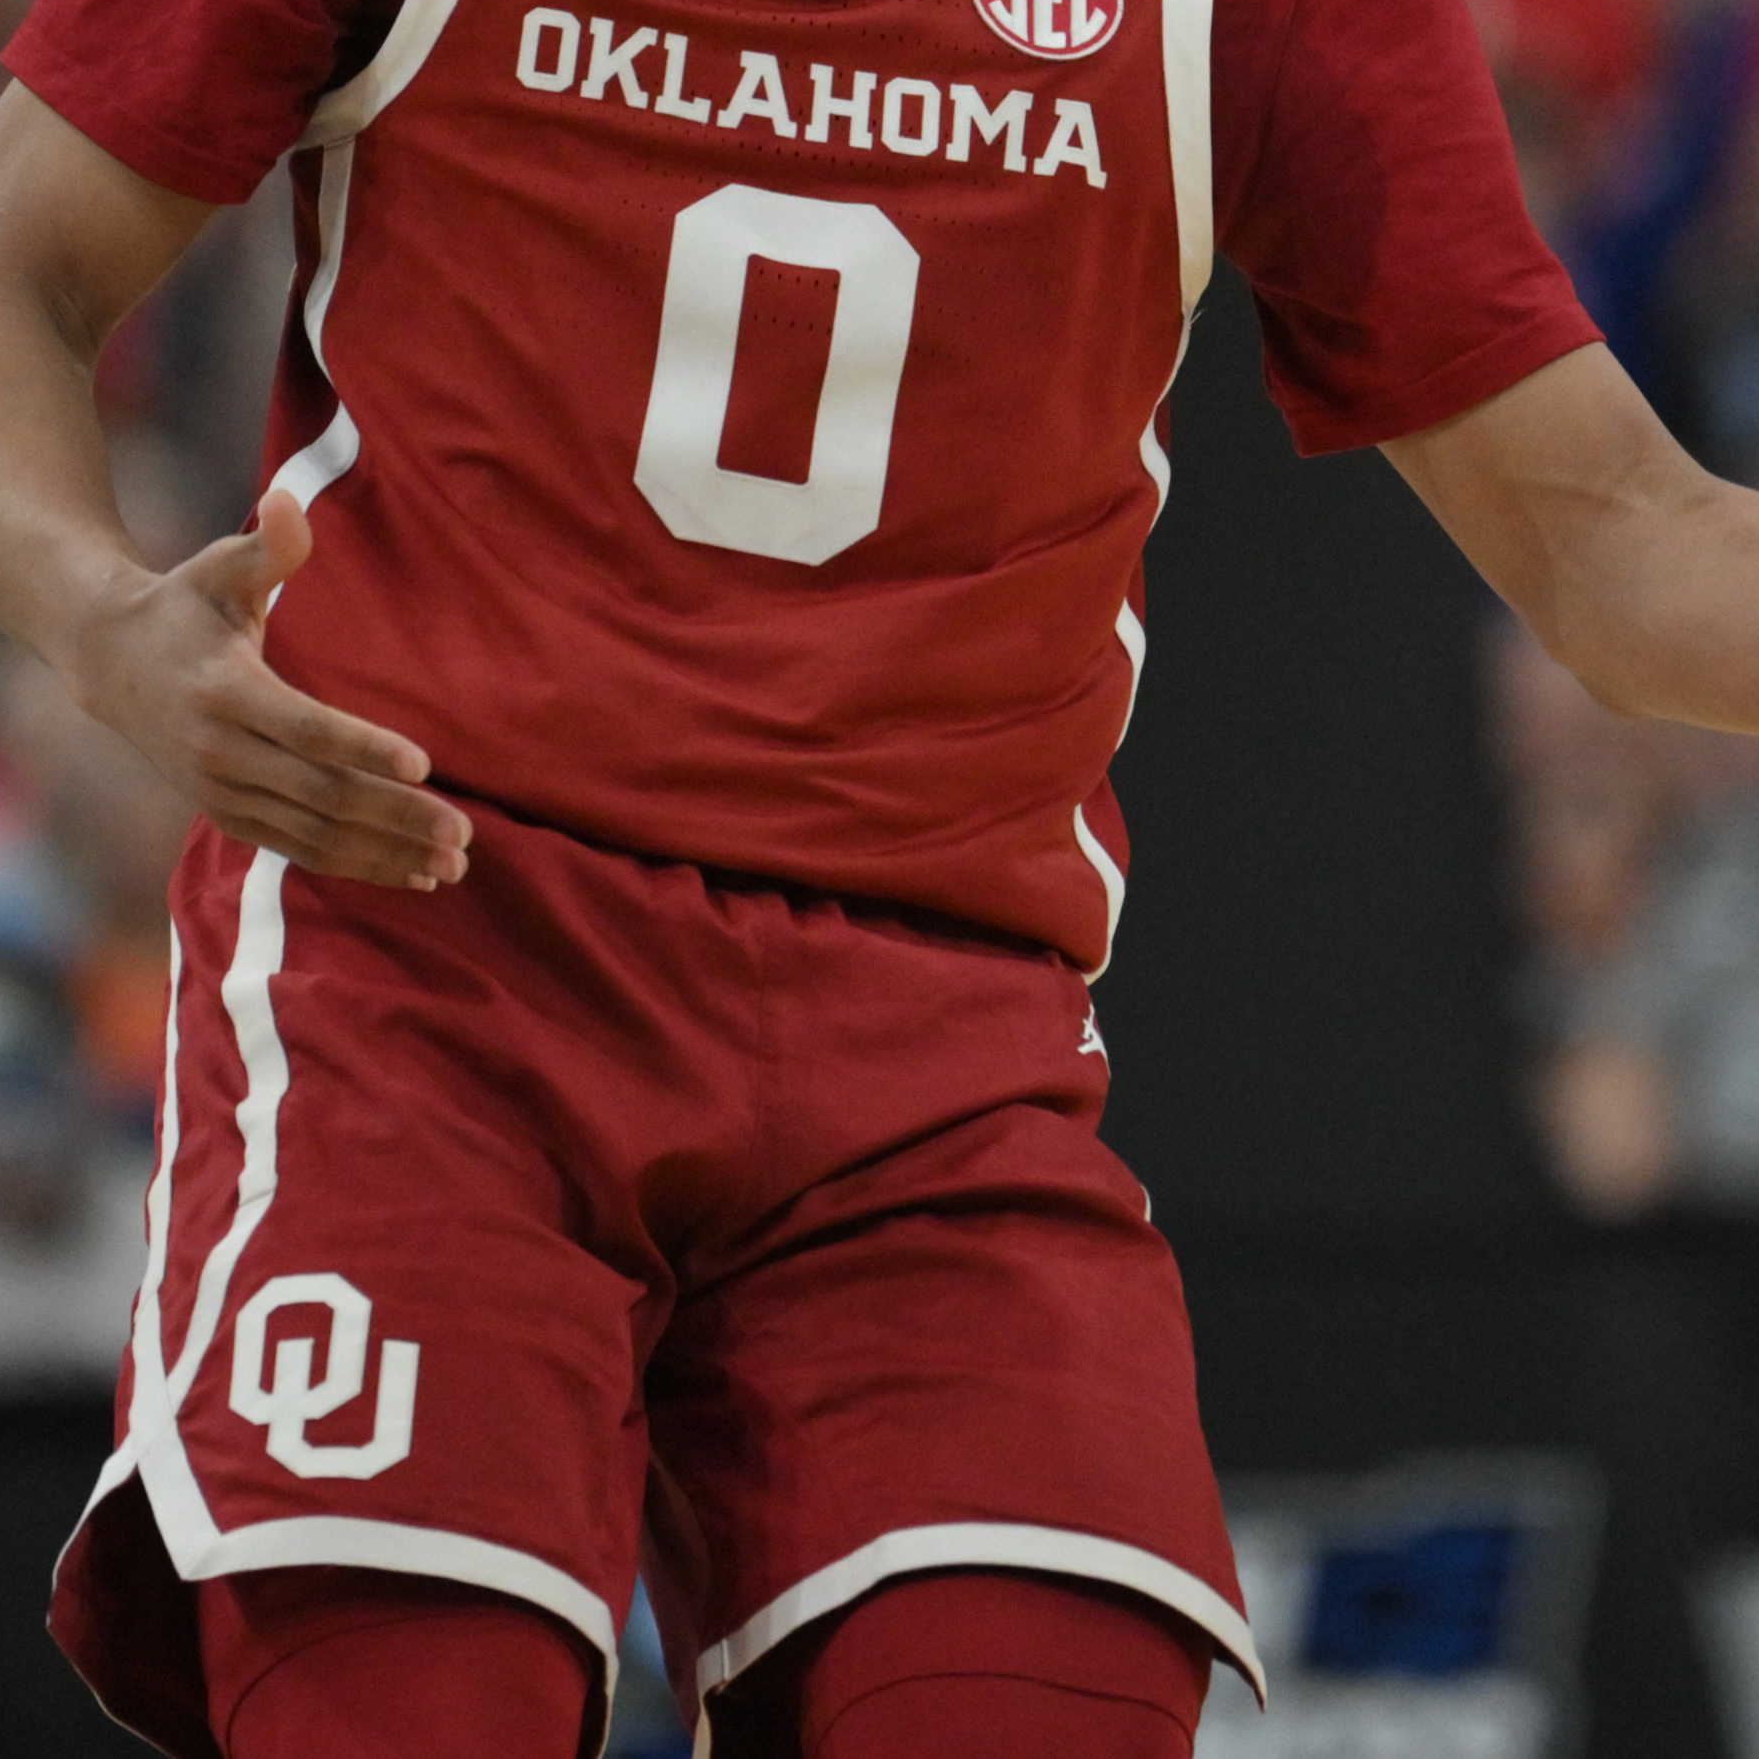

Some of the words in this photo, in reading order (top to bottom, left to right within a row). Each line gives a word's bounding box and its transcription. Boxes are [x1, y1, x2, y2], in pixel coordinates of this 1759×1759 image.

[516, 7, 1107, 189] OKLAHOMA
[633, 183, 921, 566] 0
[228, 1272, 420, 1479] OU
